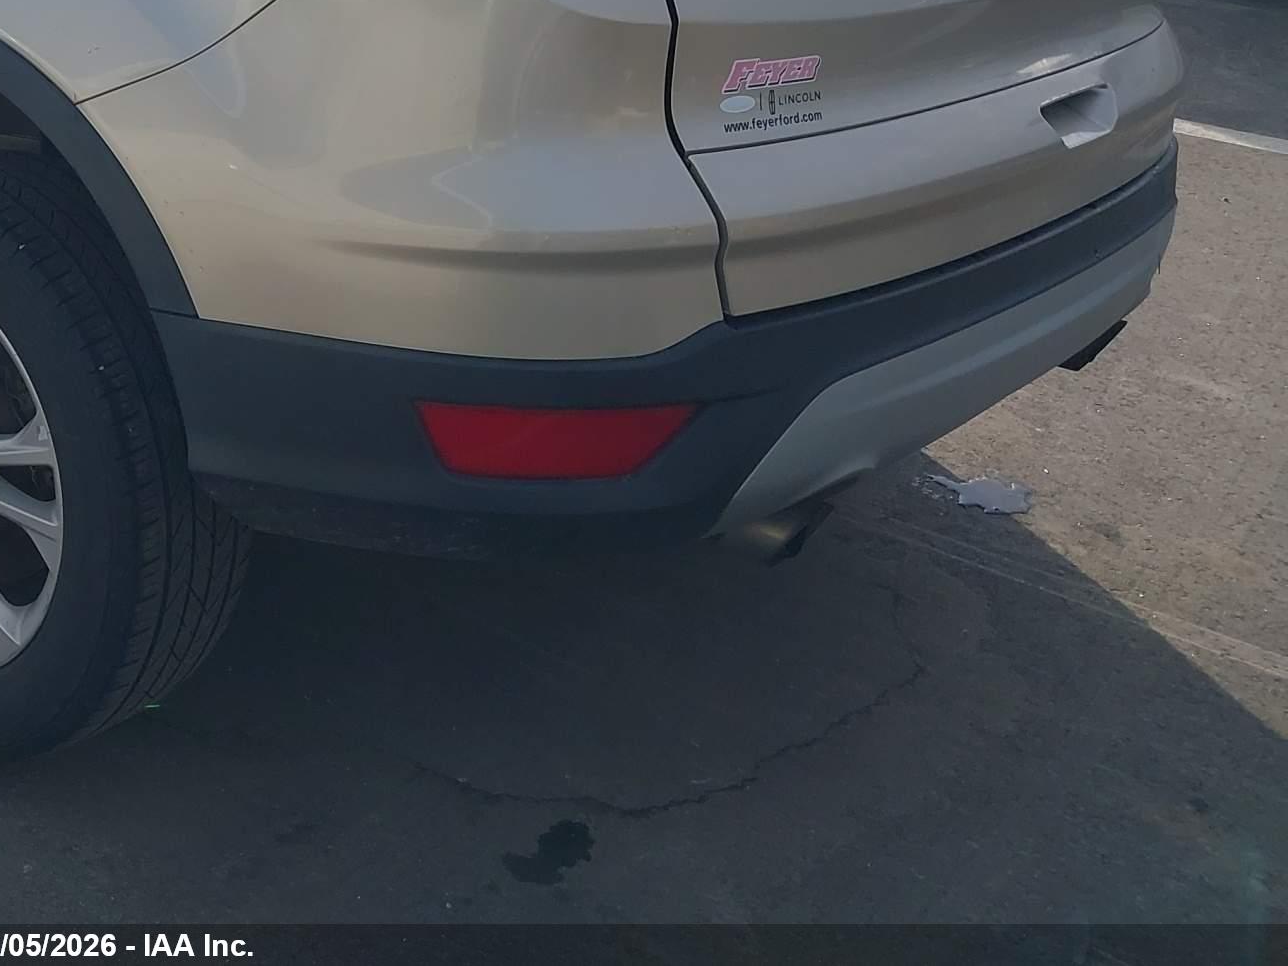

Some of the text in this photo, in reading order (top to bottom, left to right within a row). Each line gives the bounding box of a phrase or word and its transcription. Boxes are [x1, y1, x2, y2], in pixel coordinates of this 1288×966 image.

[722, 55, 821, 94] FEYER
[778, 90, 822, 106] LINCOLN
[723, 111, 823, 134] www.feyerford.com
